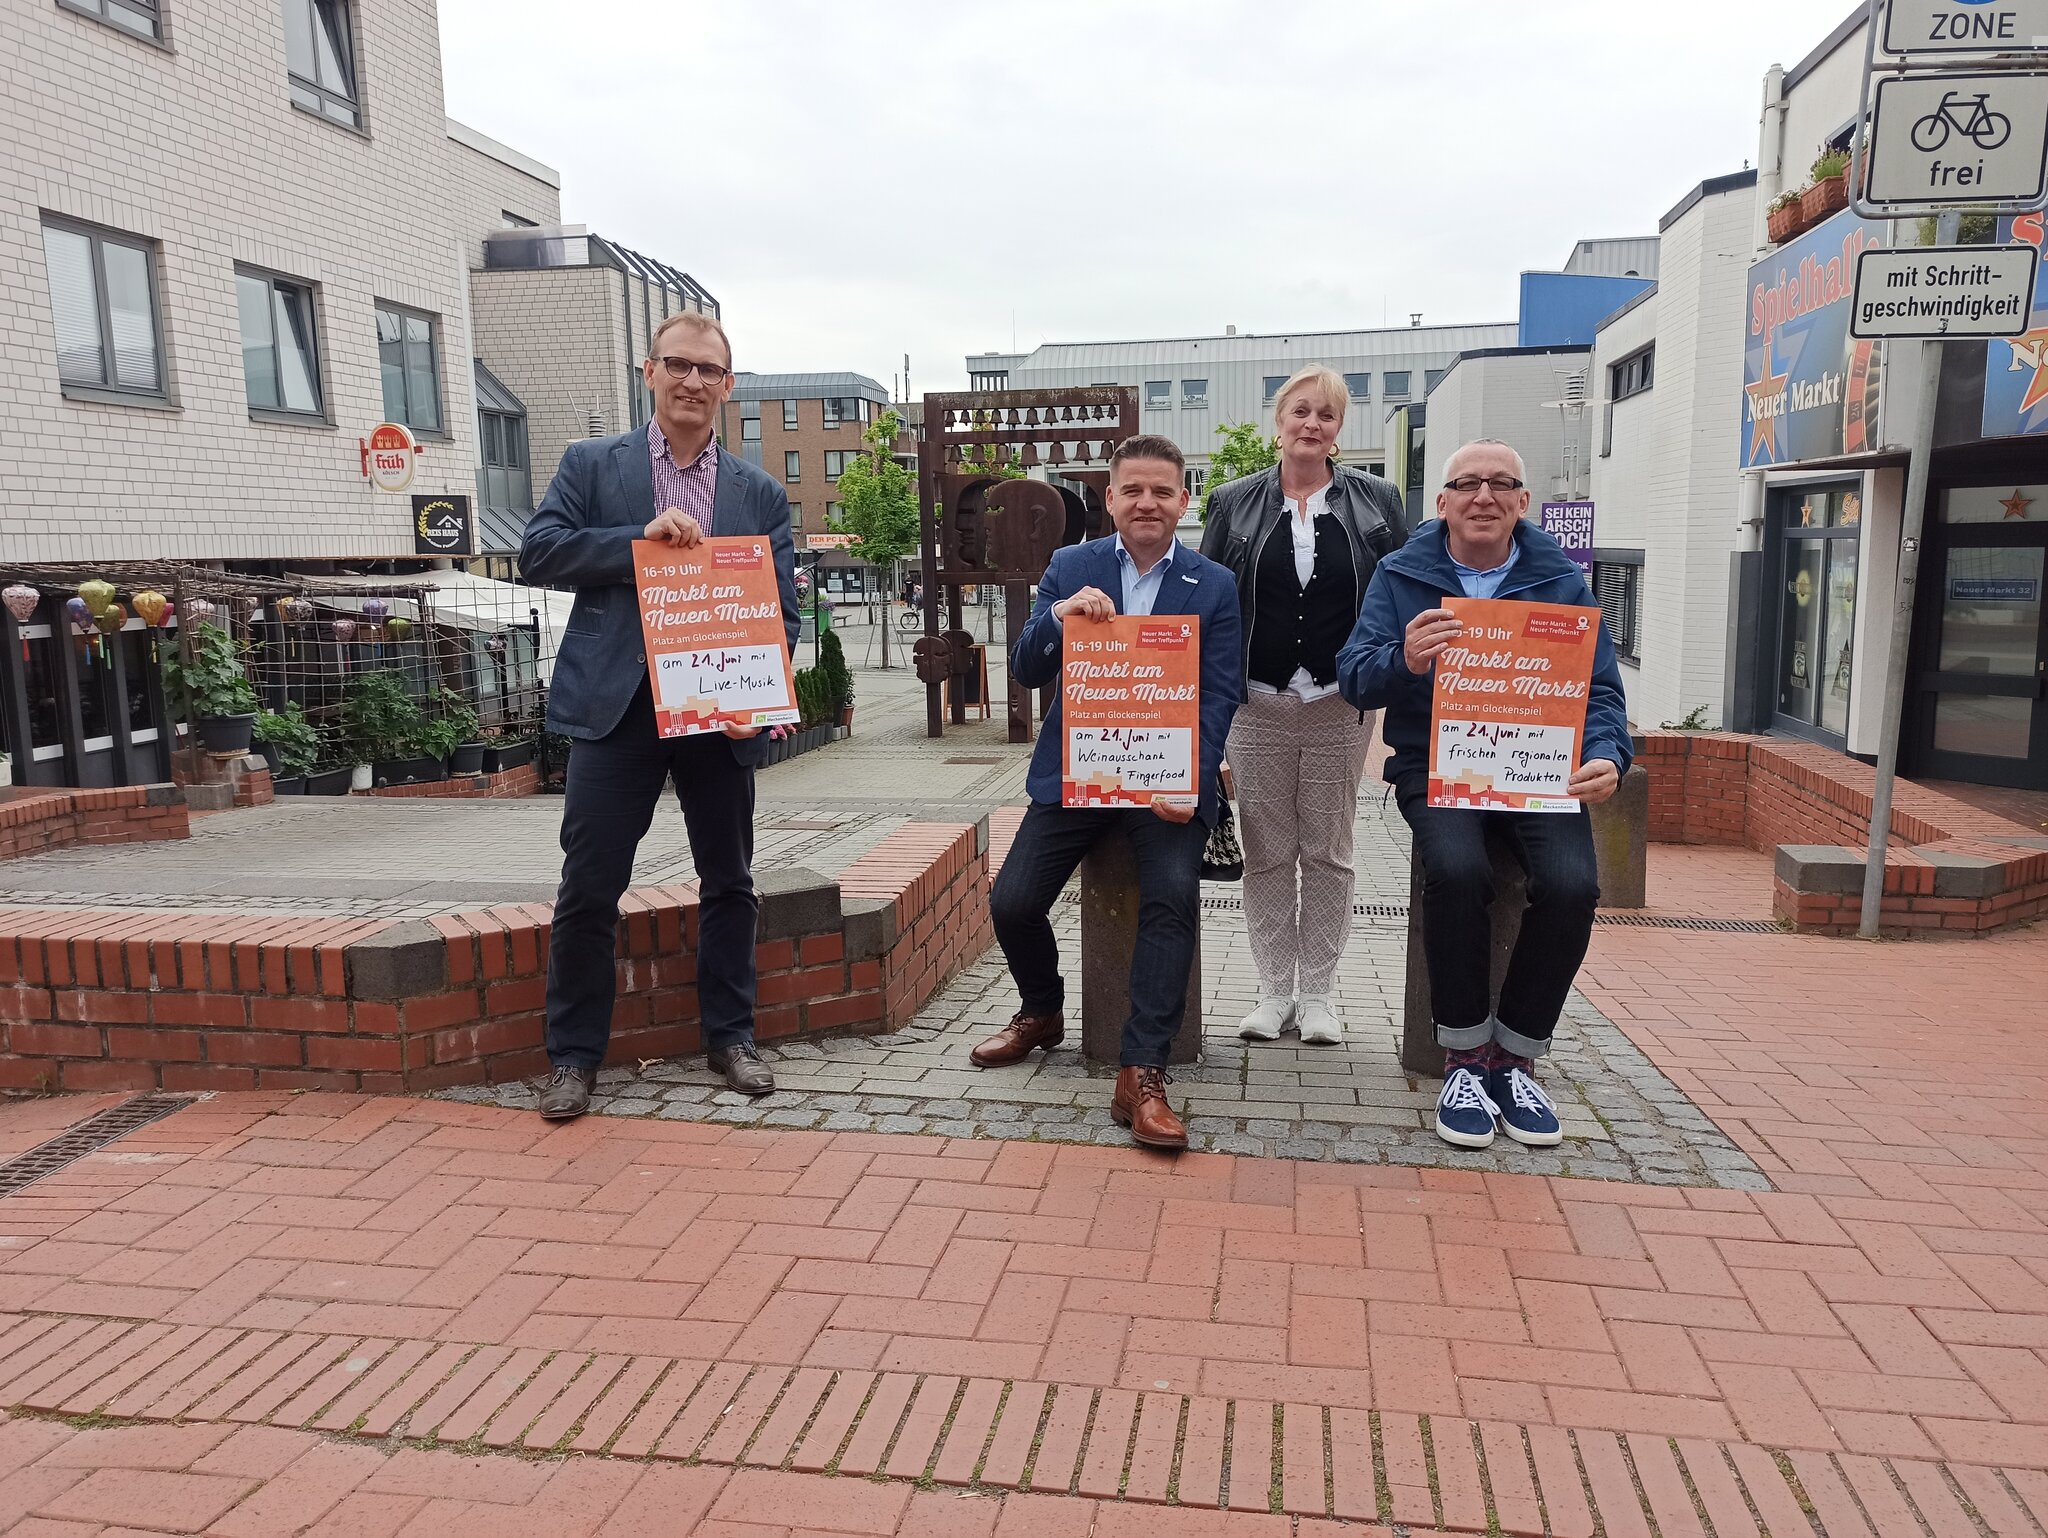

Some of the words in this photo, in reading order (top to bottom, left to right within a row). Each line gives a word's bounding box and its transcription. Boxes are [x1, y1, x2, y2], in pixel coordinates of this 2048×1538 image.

[1929, 12, 2016, 40] ZONE
[1930, 159, 1984, 187] frei
[1887, 266, 1918, 288] mit
[1924, 265, 2002, 287] Schritt-
[1862, 293, 2020, 324] geschwindigkeit
[1746, 390, 1788, 424] Neuer
[374, 453, 405, 471] früh
[1545, 507, 1563, 519] SEI
[1565, 506, 1592, 519] KEIN
[1545, 519, 1591, 532] ARSCH
[1555, 532, 1591, 549] OCH
[642, 565, 676, 578] 16-19
[679, 564, 703, 577] Uhr
[641, 583, 710, 608] Markt
[712, 584, 745, 600] am
[1956, 586, 1985, 594] Neuer
[1986, 586, 2016, 594] Markt
[2018, 586, 2031, 594] 32
[645, 609, 712, 631] Neuen
[714, 601, 779, 627] Markt
[1550, 620, 1567, 628] Markt
[652, 636, 675, 646] Platz
[676, 635, 690, 643] am
[692, 629, 748, 643] Glockenspiel
[1487, 627, 1513, 641] Uhr
[1549, 627, 1580, 636] Treffpunkt
[1070, 641, 1102, 652] 16-19
[1106, 640, 1128, 652] Uhr
[662, 659, 682, 669] am
[691, 653, 714, 669] 21.
[716, 651, 742, 672] Juni
[750, 652, 766, 661] mit
[1441, 647, 1512, 672] Markt
[1514, 655, 1552, 672] am
[1066, 660, 1131, 682] Markt
[1132, 665, 1164, 679] am
[699, 675, 776, 695] Live-Musik
[1066, 683, 1130, 704] Neuen
[1131, 683, 1196, 705] Markt
[1438, 672, 1509, 695] Neuen
[1511, 675, 1586, 700] Markt
[1070, 711, 1090, 719] Platz
[1107, 710, 1161, 720] Glockenspiel
[1440, 702, 1463, 711] Platz
[1465, 703, 1480, 712] am
[1482, 704, 1543, 716] Glockenspiel
[1075, 731, 1093, 740] am
[1100, 728, 1122, 742] 21.
[1122, 729, 1150, 750] Juni
[1157, 732, 1171, 740] mit
[1442, 724, 1459, 733] am
[1466, 722, 1489, 738] 21.
[1490, 725, 1520, 746] Juni
[1528, 729, 1545, 739] mit
[1078, 748, 1165, 763] Weinausschank
[1511, 749, 1568, 768] regionalen
[1127, 769, 1185, 787] Fingerfood
[1504, 766, 1562, 783] Produkten
